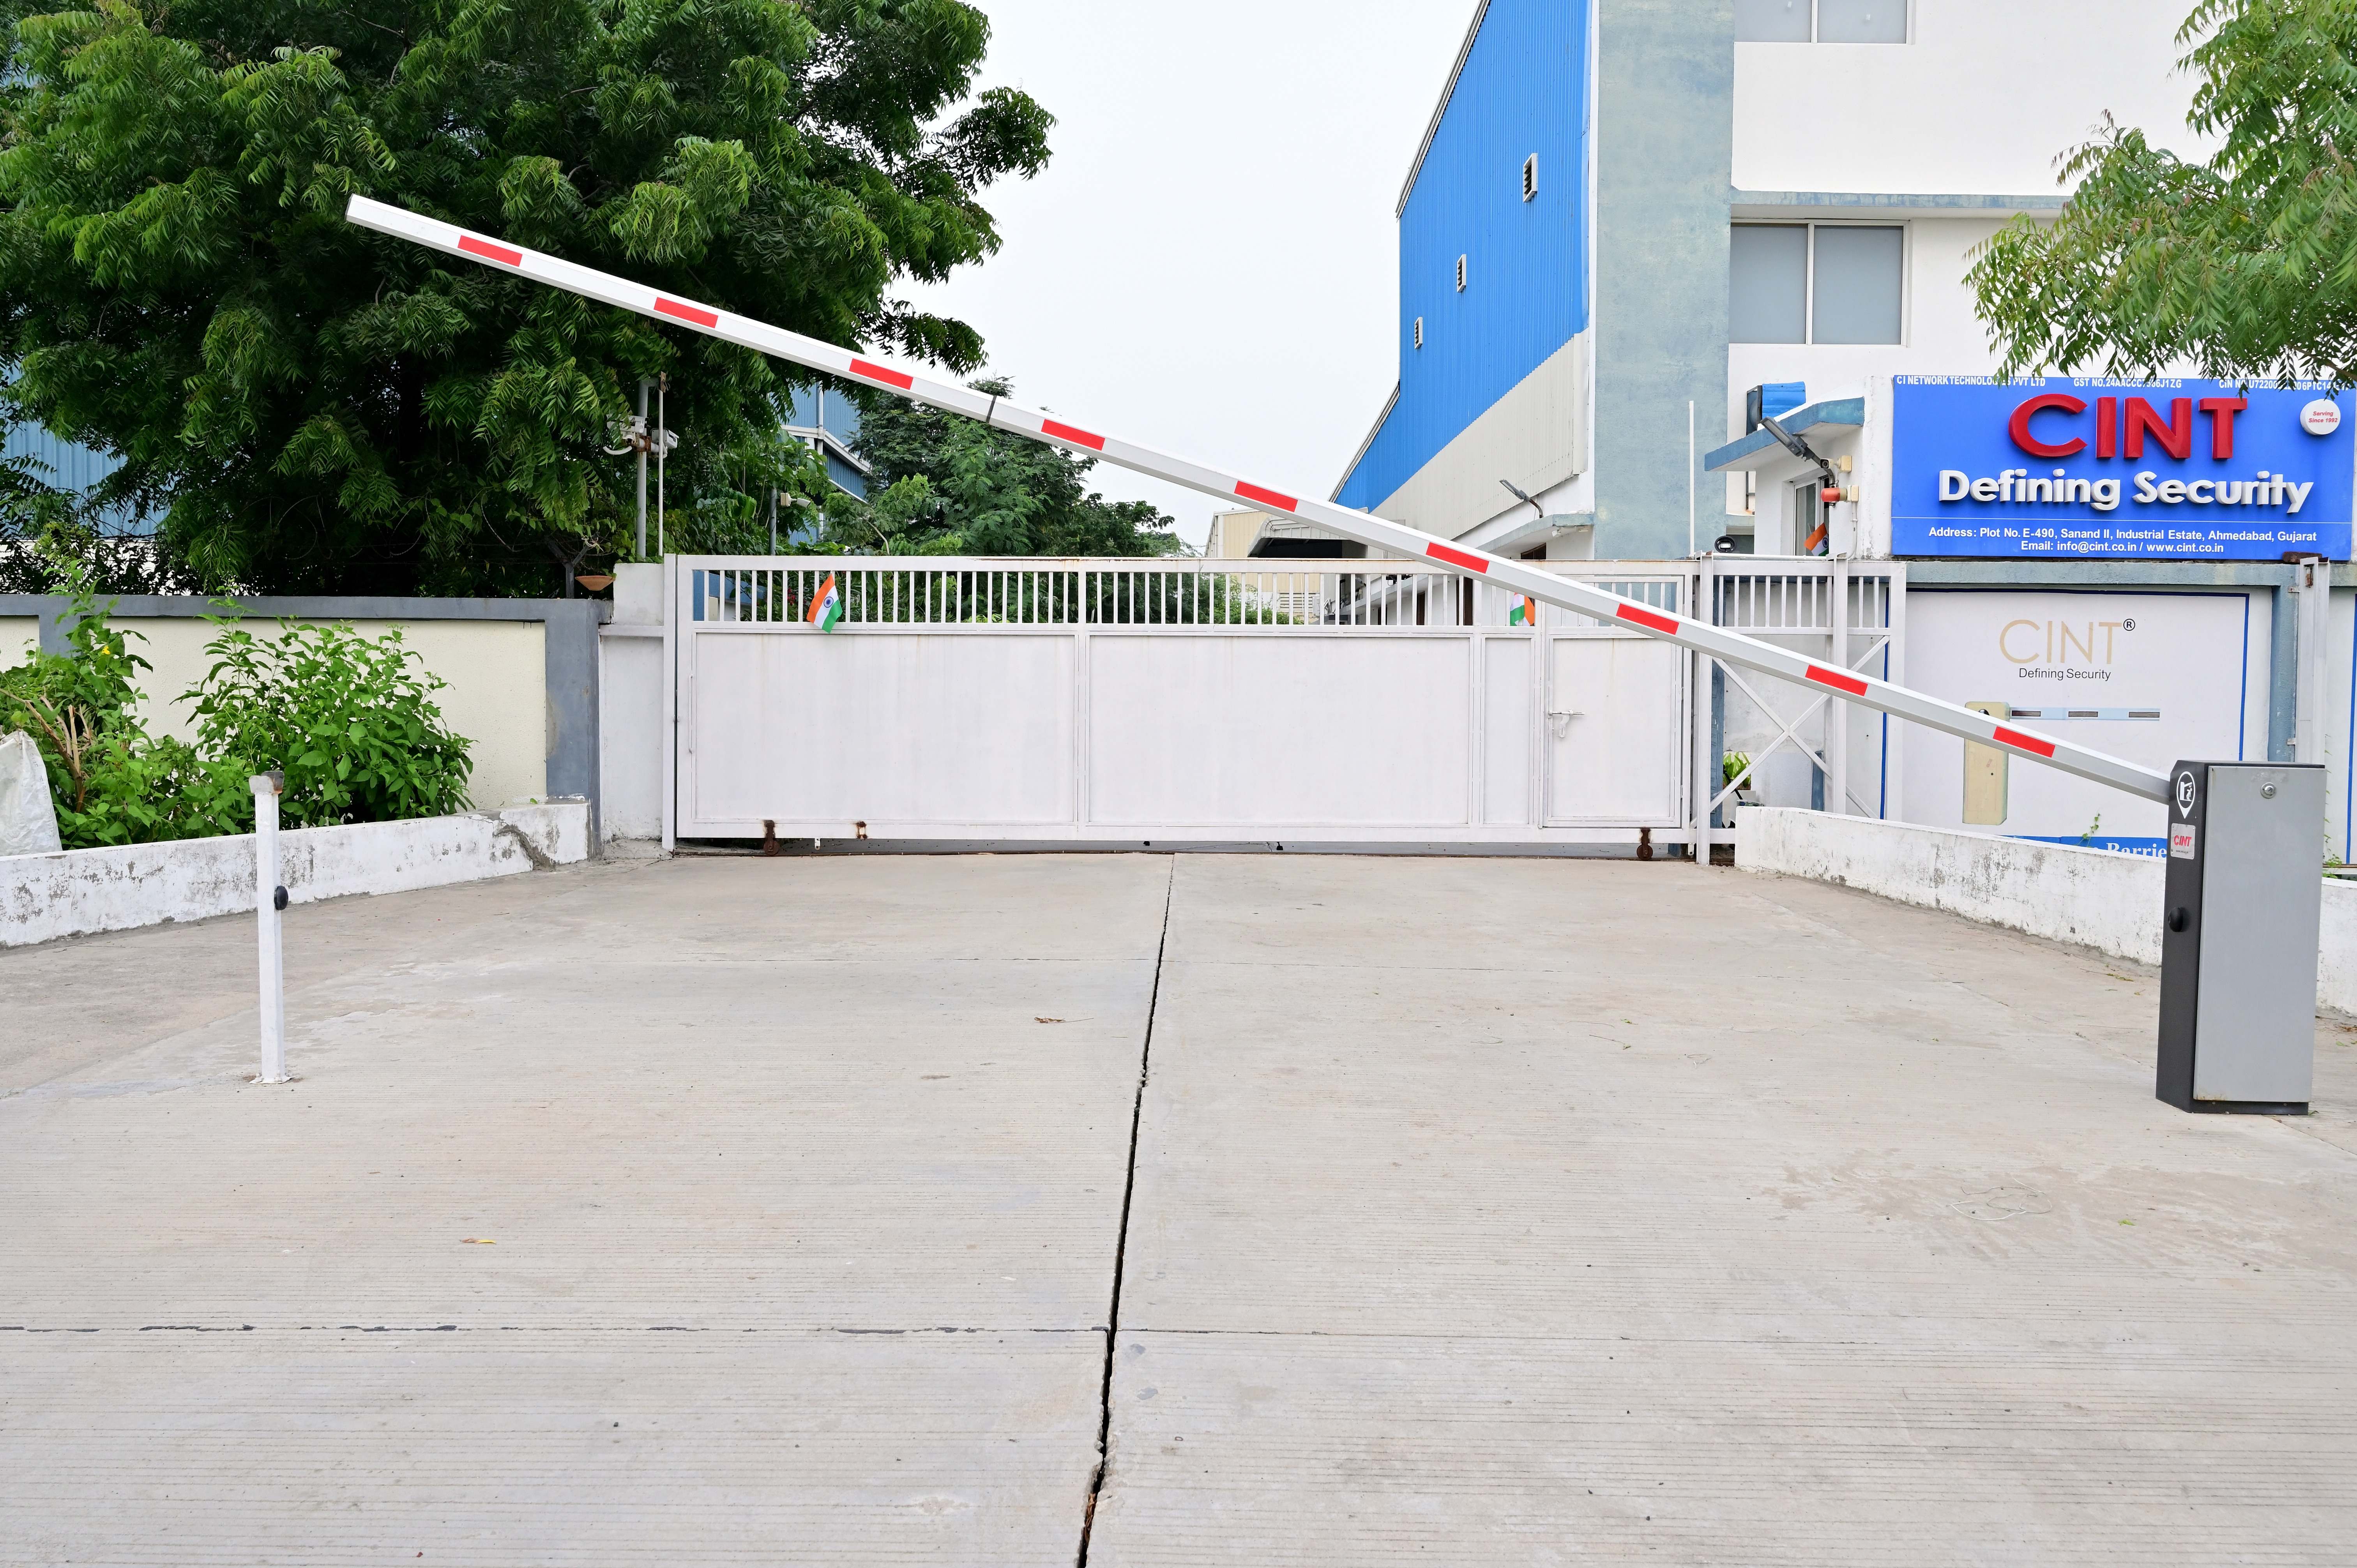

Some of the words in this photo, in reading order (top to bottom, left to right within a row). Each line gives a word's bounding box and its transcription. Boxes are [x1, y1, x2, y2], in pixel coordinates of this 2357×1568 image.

[1908, 376, 1949, 385] NETWORK
[1949, 376, 2011, 386] TECHNOLOS
[2013, 377, 2028, 386] PVT
[2030, 378, 2046, 387] LTD
[2074, 378, 2089, 387] GST
[2008, 394, 2248, 460] CINT
[1939, 468, 2120, 511] Defining
[2132, 470, 2314, 514] Security
[1928, 527, 1976, 537] Address:
[1980, 528, 2000, 537] Plot
[2023, 528, 2057, 539] E-490,
[2061, 528, 2100, 538] Sanand
[2117, 530, 2164, 539] Industrial
[2168, 530, 2205, 541] Estate,
[2208, 531, 2274, 542] Ahmedabad,
[2277, 531, 2317, 543] Gujarat
[2021, 540, 2053, 550] Email:
[2057, 541, 2136, 553] info@cint.co.in
[2147, 543, 2223, 552] www.cint.co.in
[2019, 668, 2064, 681] Defining
[2066, 668, 2111, 682] Security
[2174, 835, 2192, 847] CINT
